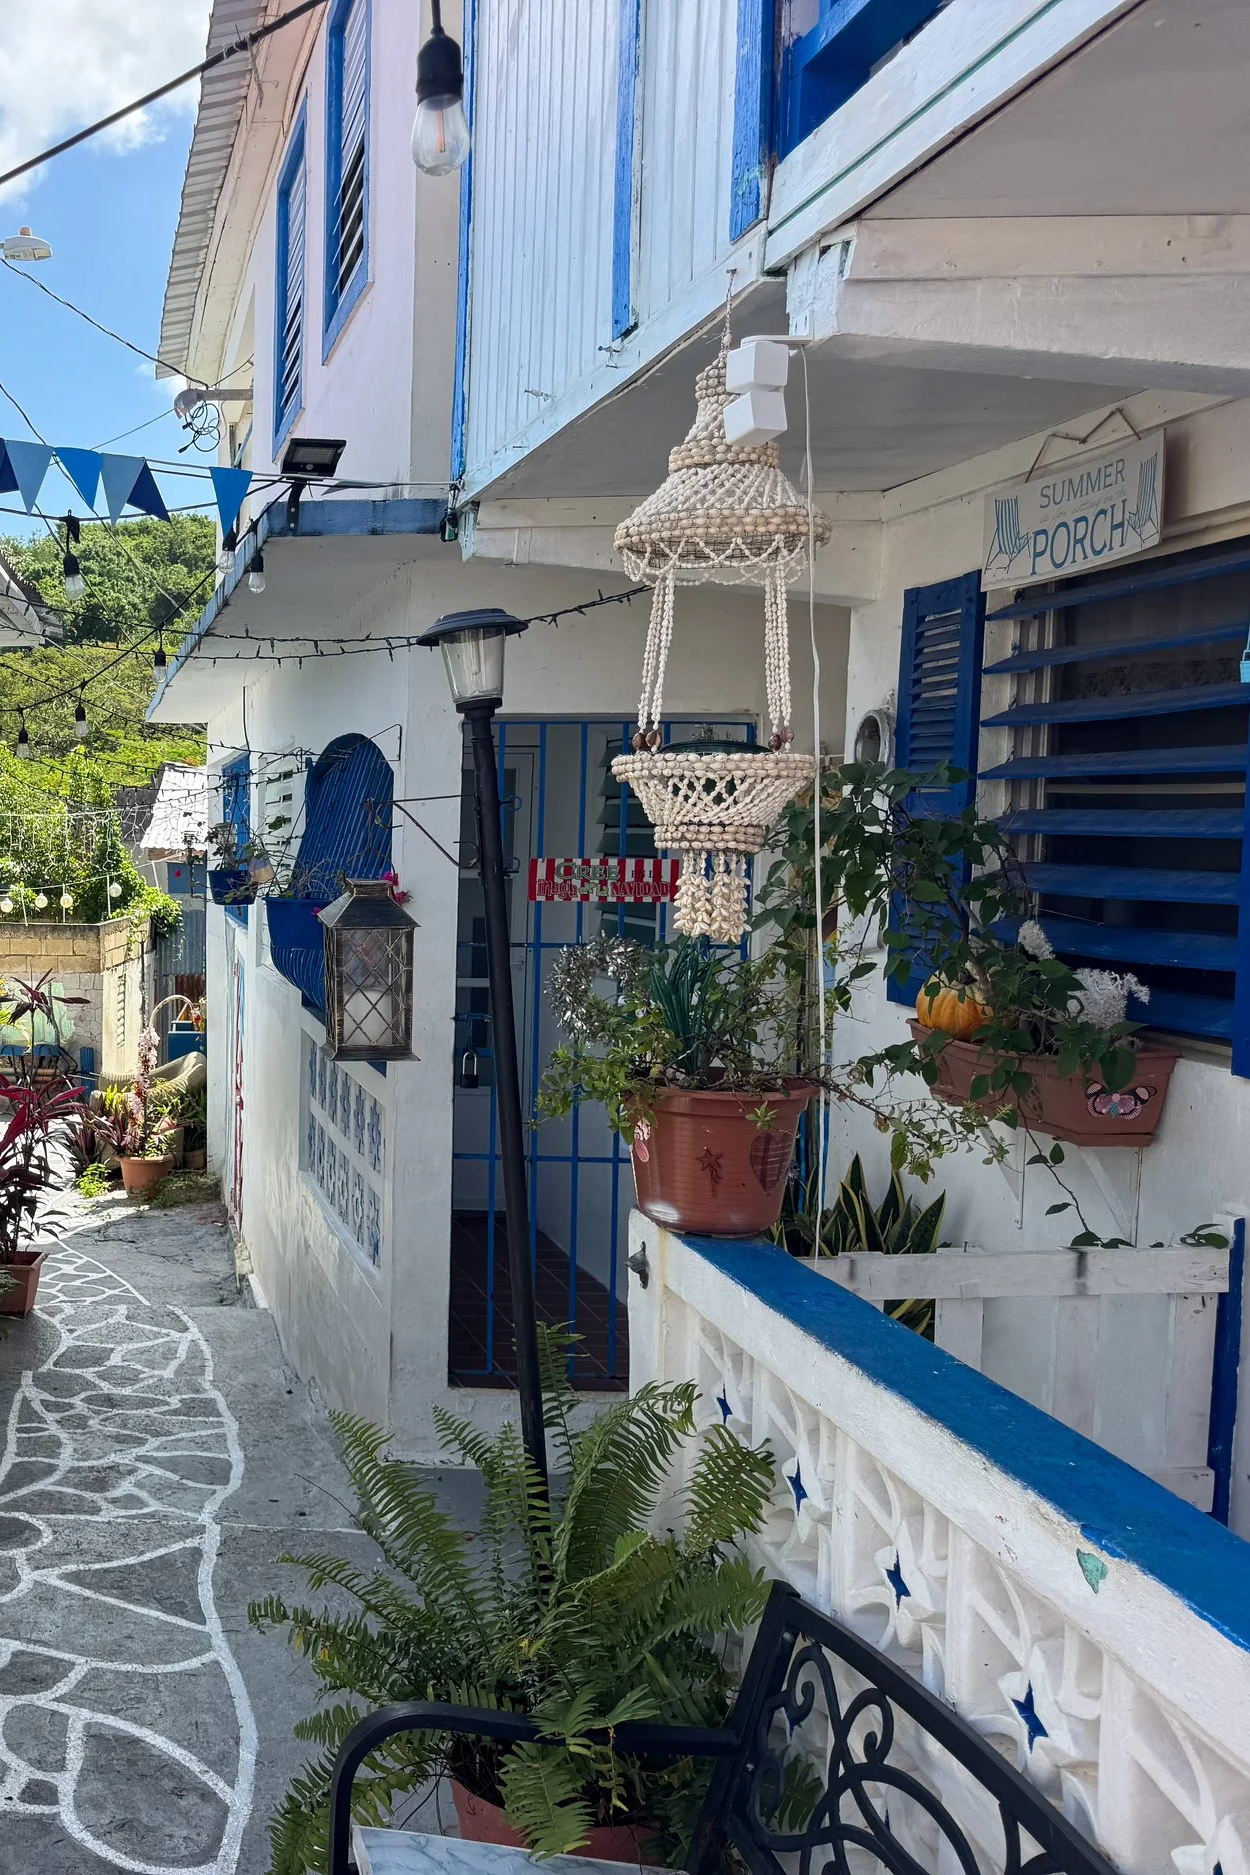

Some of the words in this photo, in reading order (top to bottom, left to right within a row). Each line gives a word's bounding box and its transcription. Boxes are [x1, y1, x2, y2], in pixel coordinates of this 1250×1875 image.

[1039, 458, 1126, 509] SUMMER
[1029, 499, 1128, 576] PORCH
[554, 861, 620, 880] CREE
[610, 881, 670, 898] NAVIDAD
